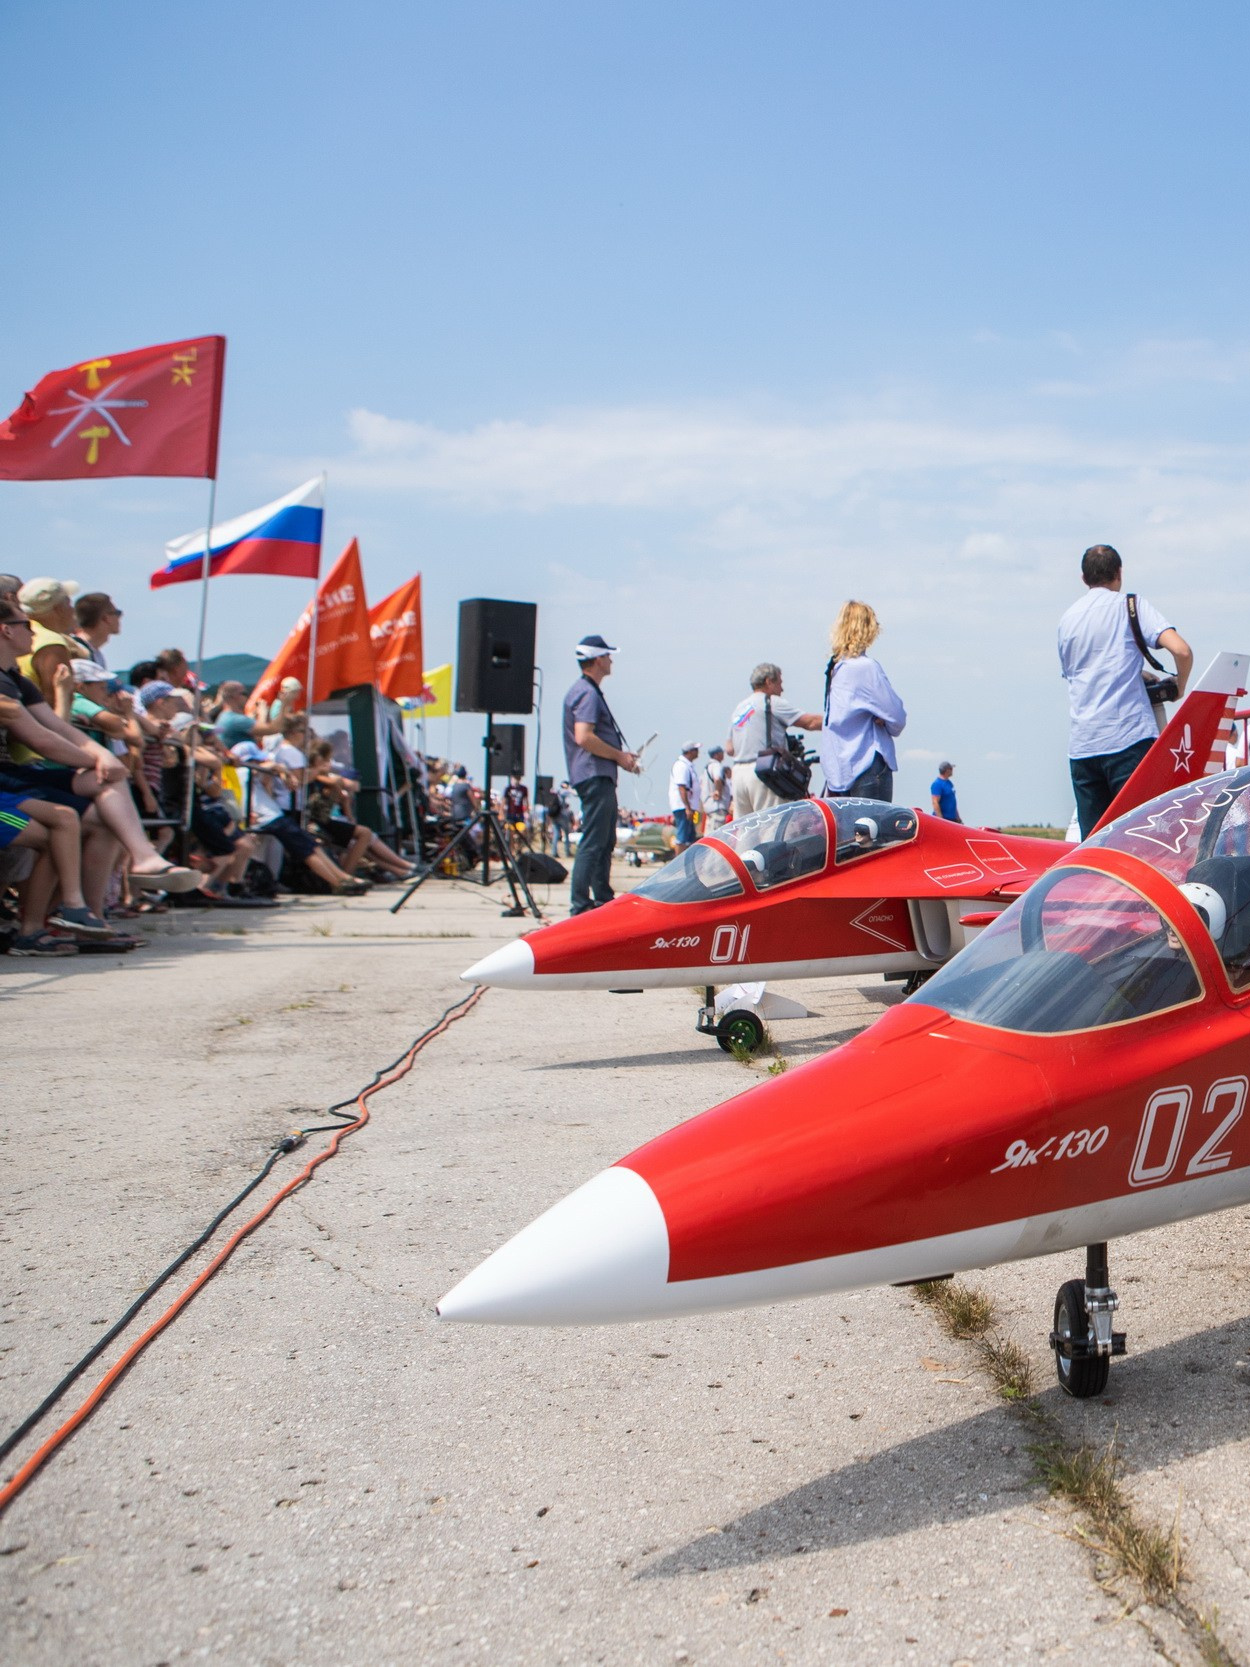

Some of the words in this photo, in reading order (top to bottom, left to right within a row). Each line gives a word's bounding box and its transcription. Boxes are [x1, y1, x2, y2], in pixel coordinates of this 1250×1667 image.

[868, 914, 895, 924] ОПАСНО
[709, 923, 751, 964] 01
[1128, 1075, 1250, 1188] 02
